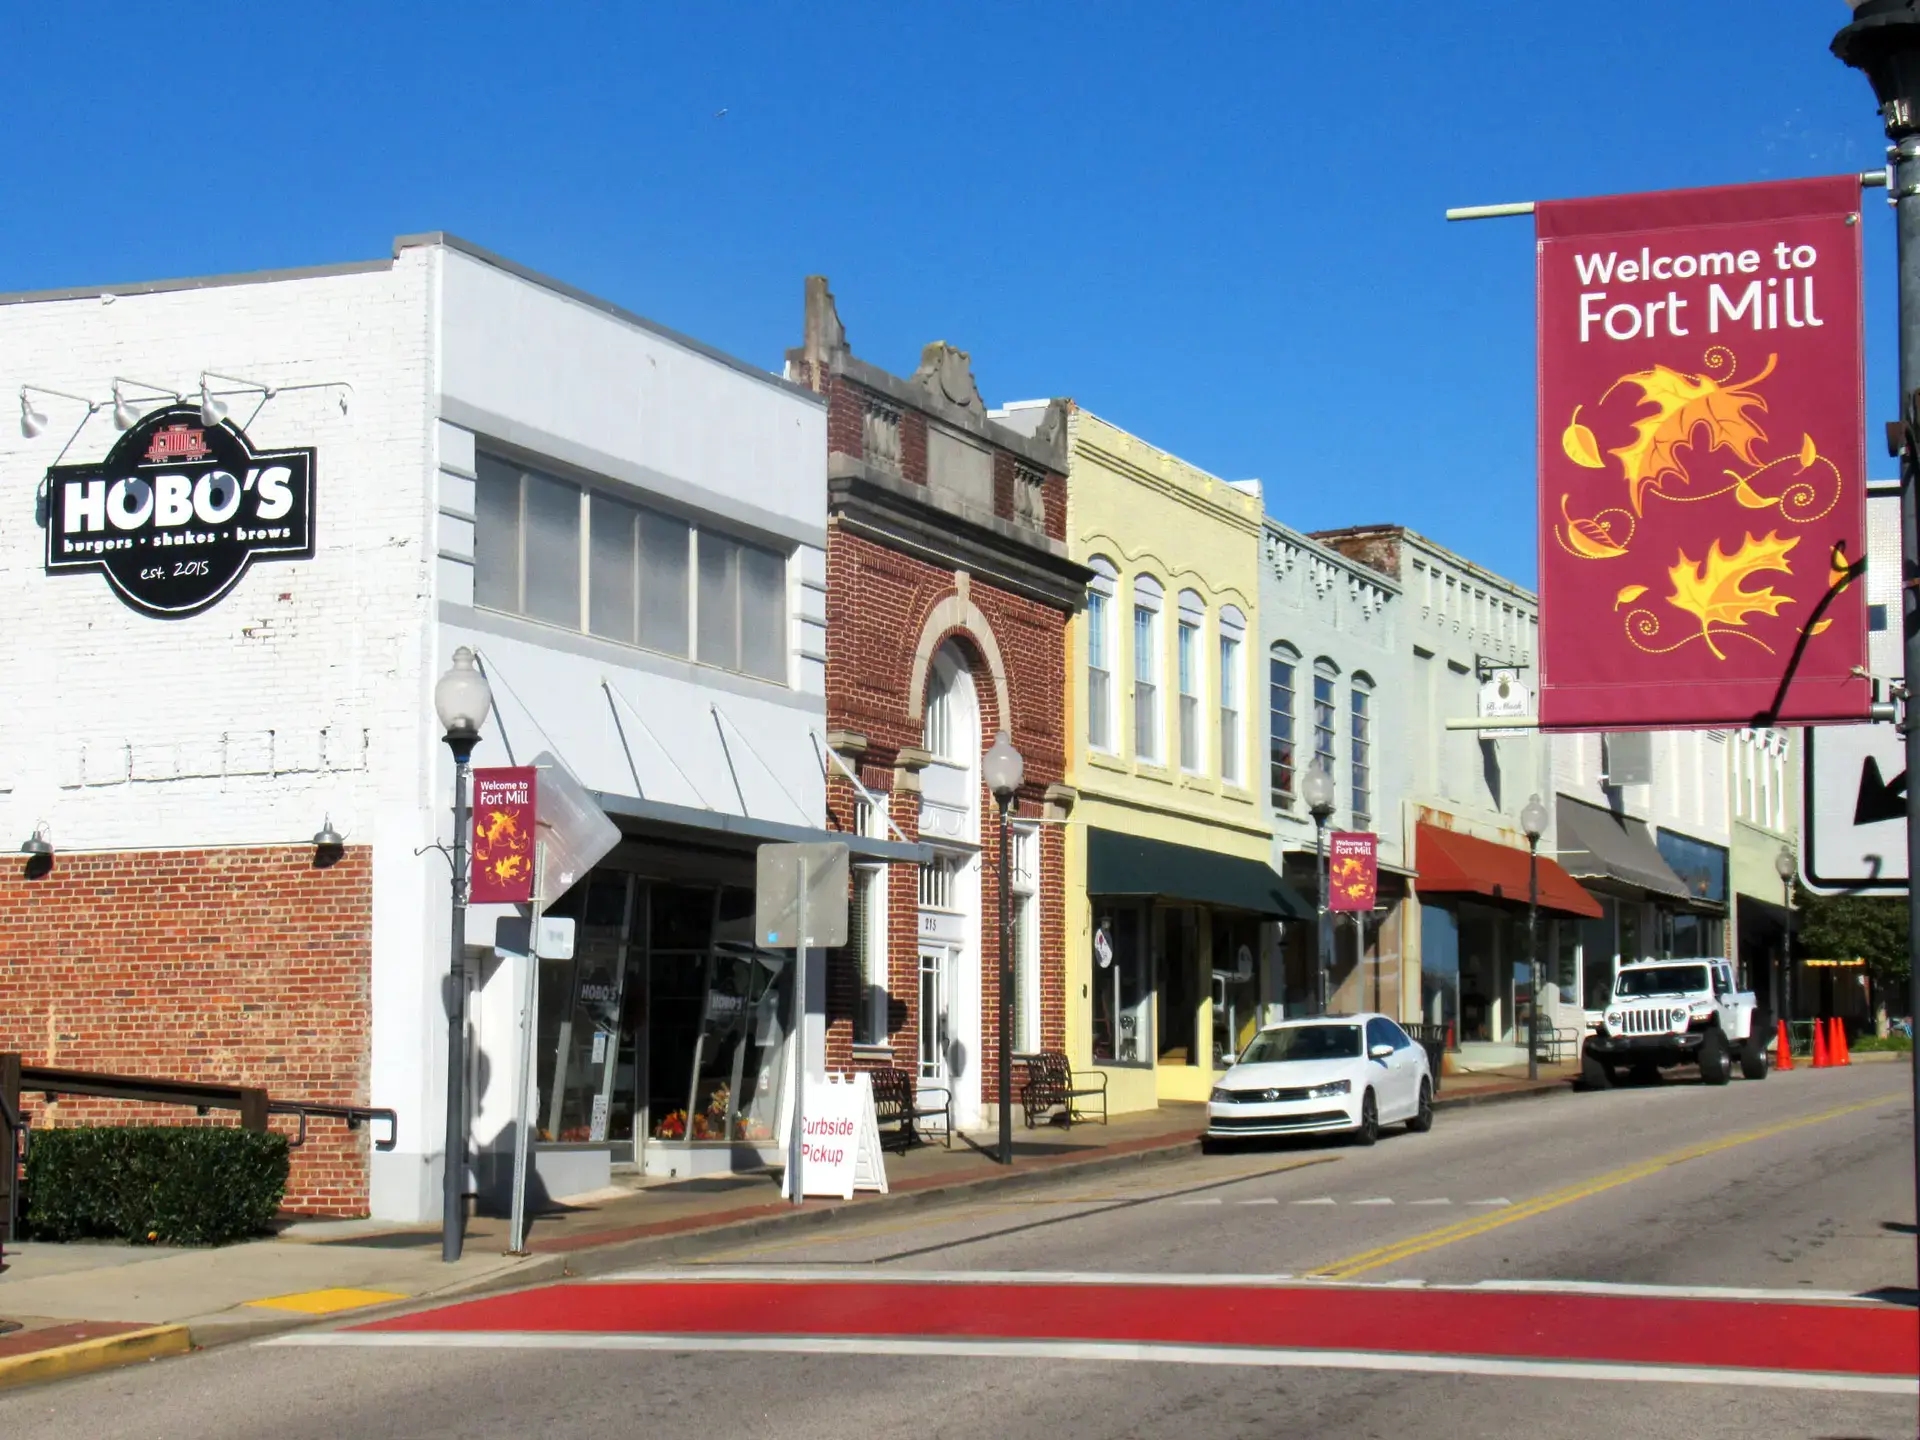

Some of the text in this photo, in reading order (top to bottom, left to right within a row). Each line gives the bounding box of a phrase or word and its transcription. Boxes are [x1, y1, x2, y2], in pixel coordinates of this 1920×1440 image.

[1574, 241, 1817, 285] Welcome to
[1580, 276, 1824, 342] Fort Mill
[63, 466, 294, 534] HOBO'S
[63, 526, 291, 554] burgers shakes brews
[172, 560, 210, 577] 2015
[480, 780, 529, 790] Welcome to
[480, 790, 529, 805] Fort Mill
[1335, 839, 1363, 847] Welcome
[1335, 846, 1372, 855] Fort Mill
[925, 917, 937, 931] 215
[802, 1143, 844, 1167] Pickup
